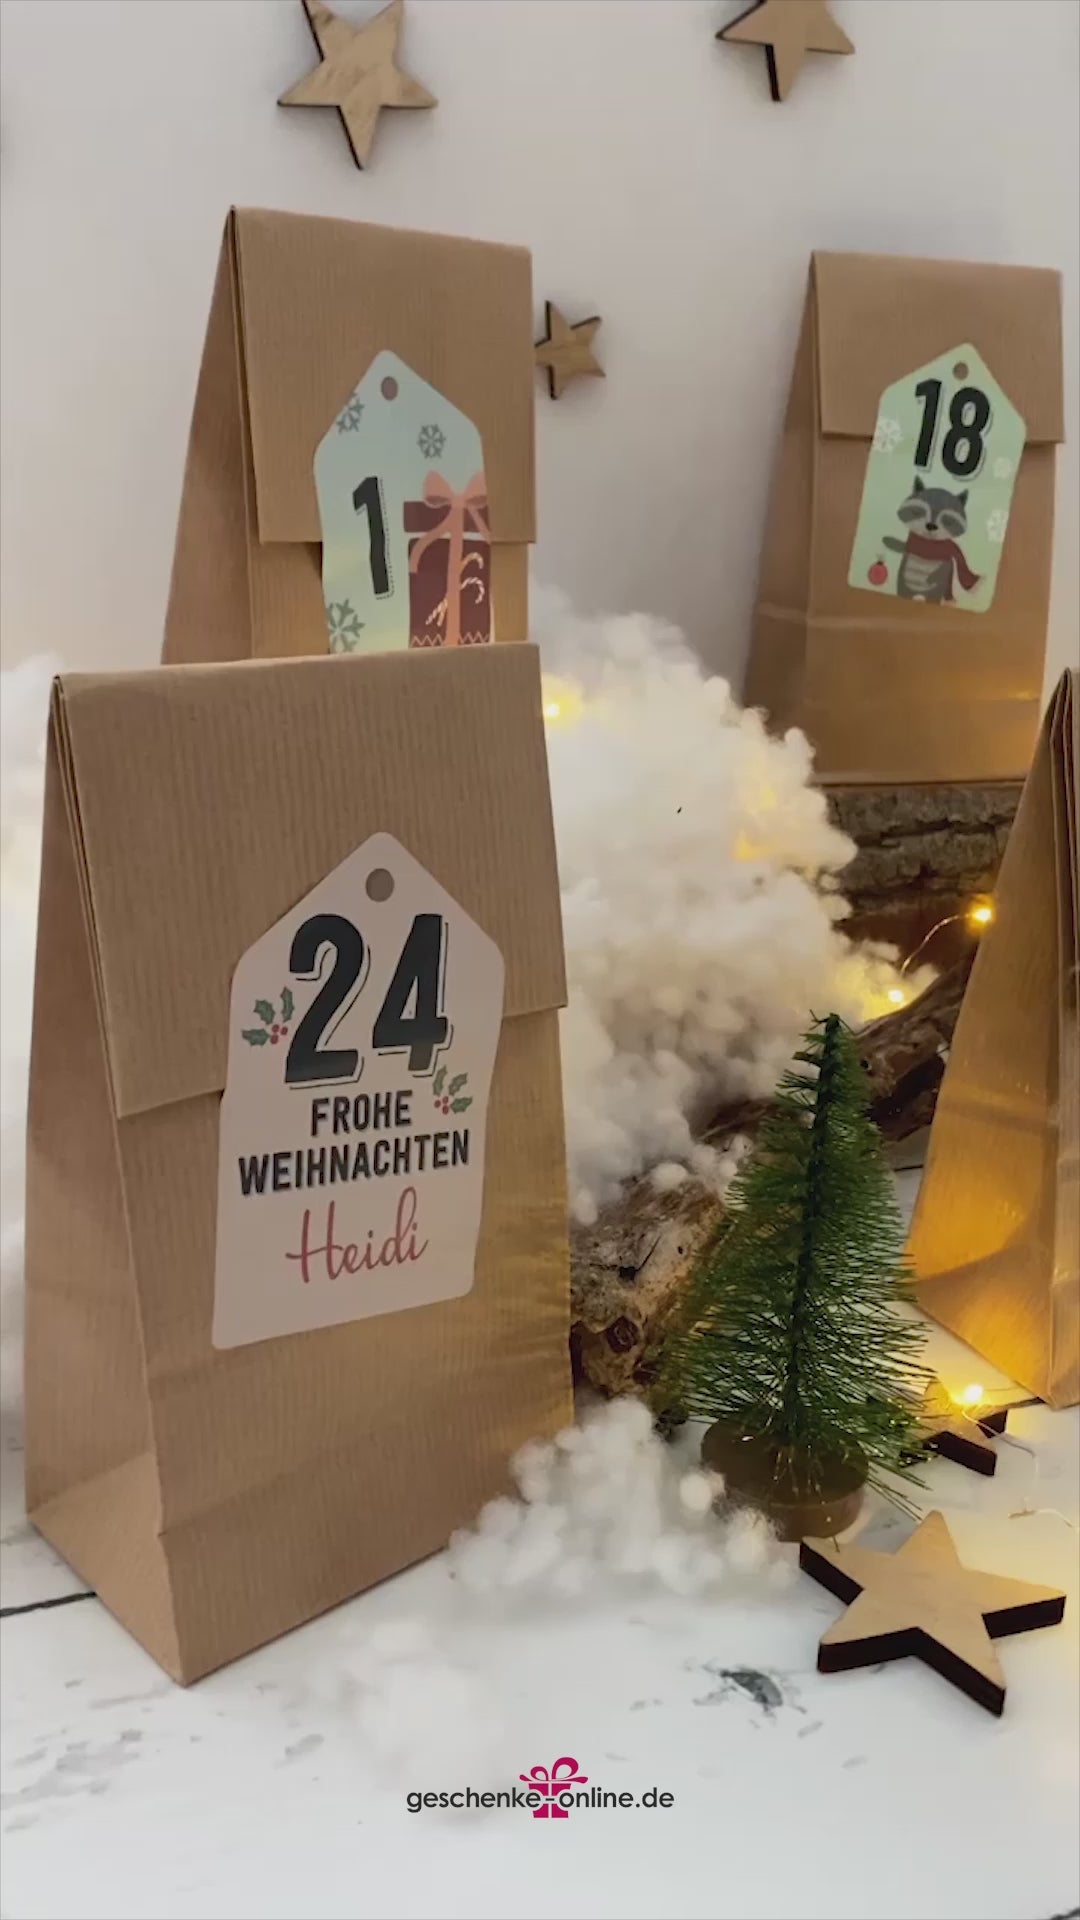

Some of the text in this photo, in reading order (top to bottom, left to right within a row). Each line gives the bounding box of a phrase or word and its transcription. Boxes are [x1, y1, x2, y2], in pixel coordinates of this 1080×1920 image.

[914, 377, 992, 480] 18
[352, 475, 393, 598] 1
[285, 913, 453, 1088] 24
[238, 1129, 470, 1196] WEIHNACHTEN
[310, 1089, 412, 1137] FROHE
[285, 1186, 429, 1284] Heidi
